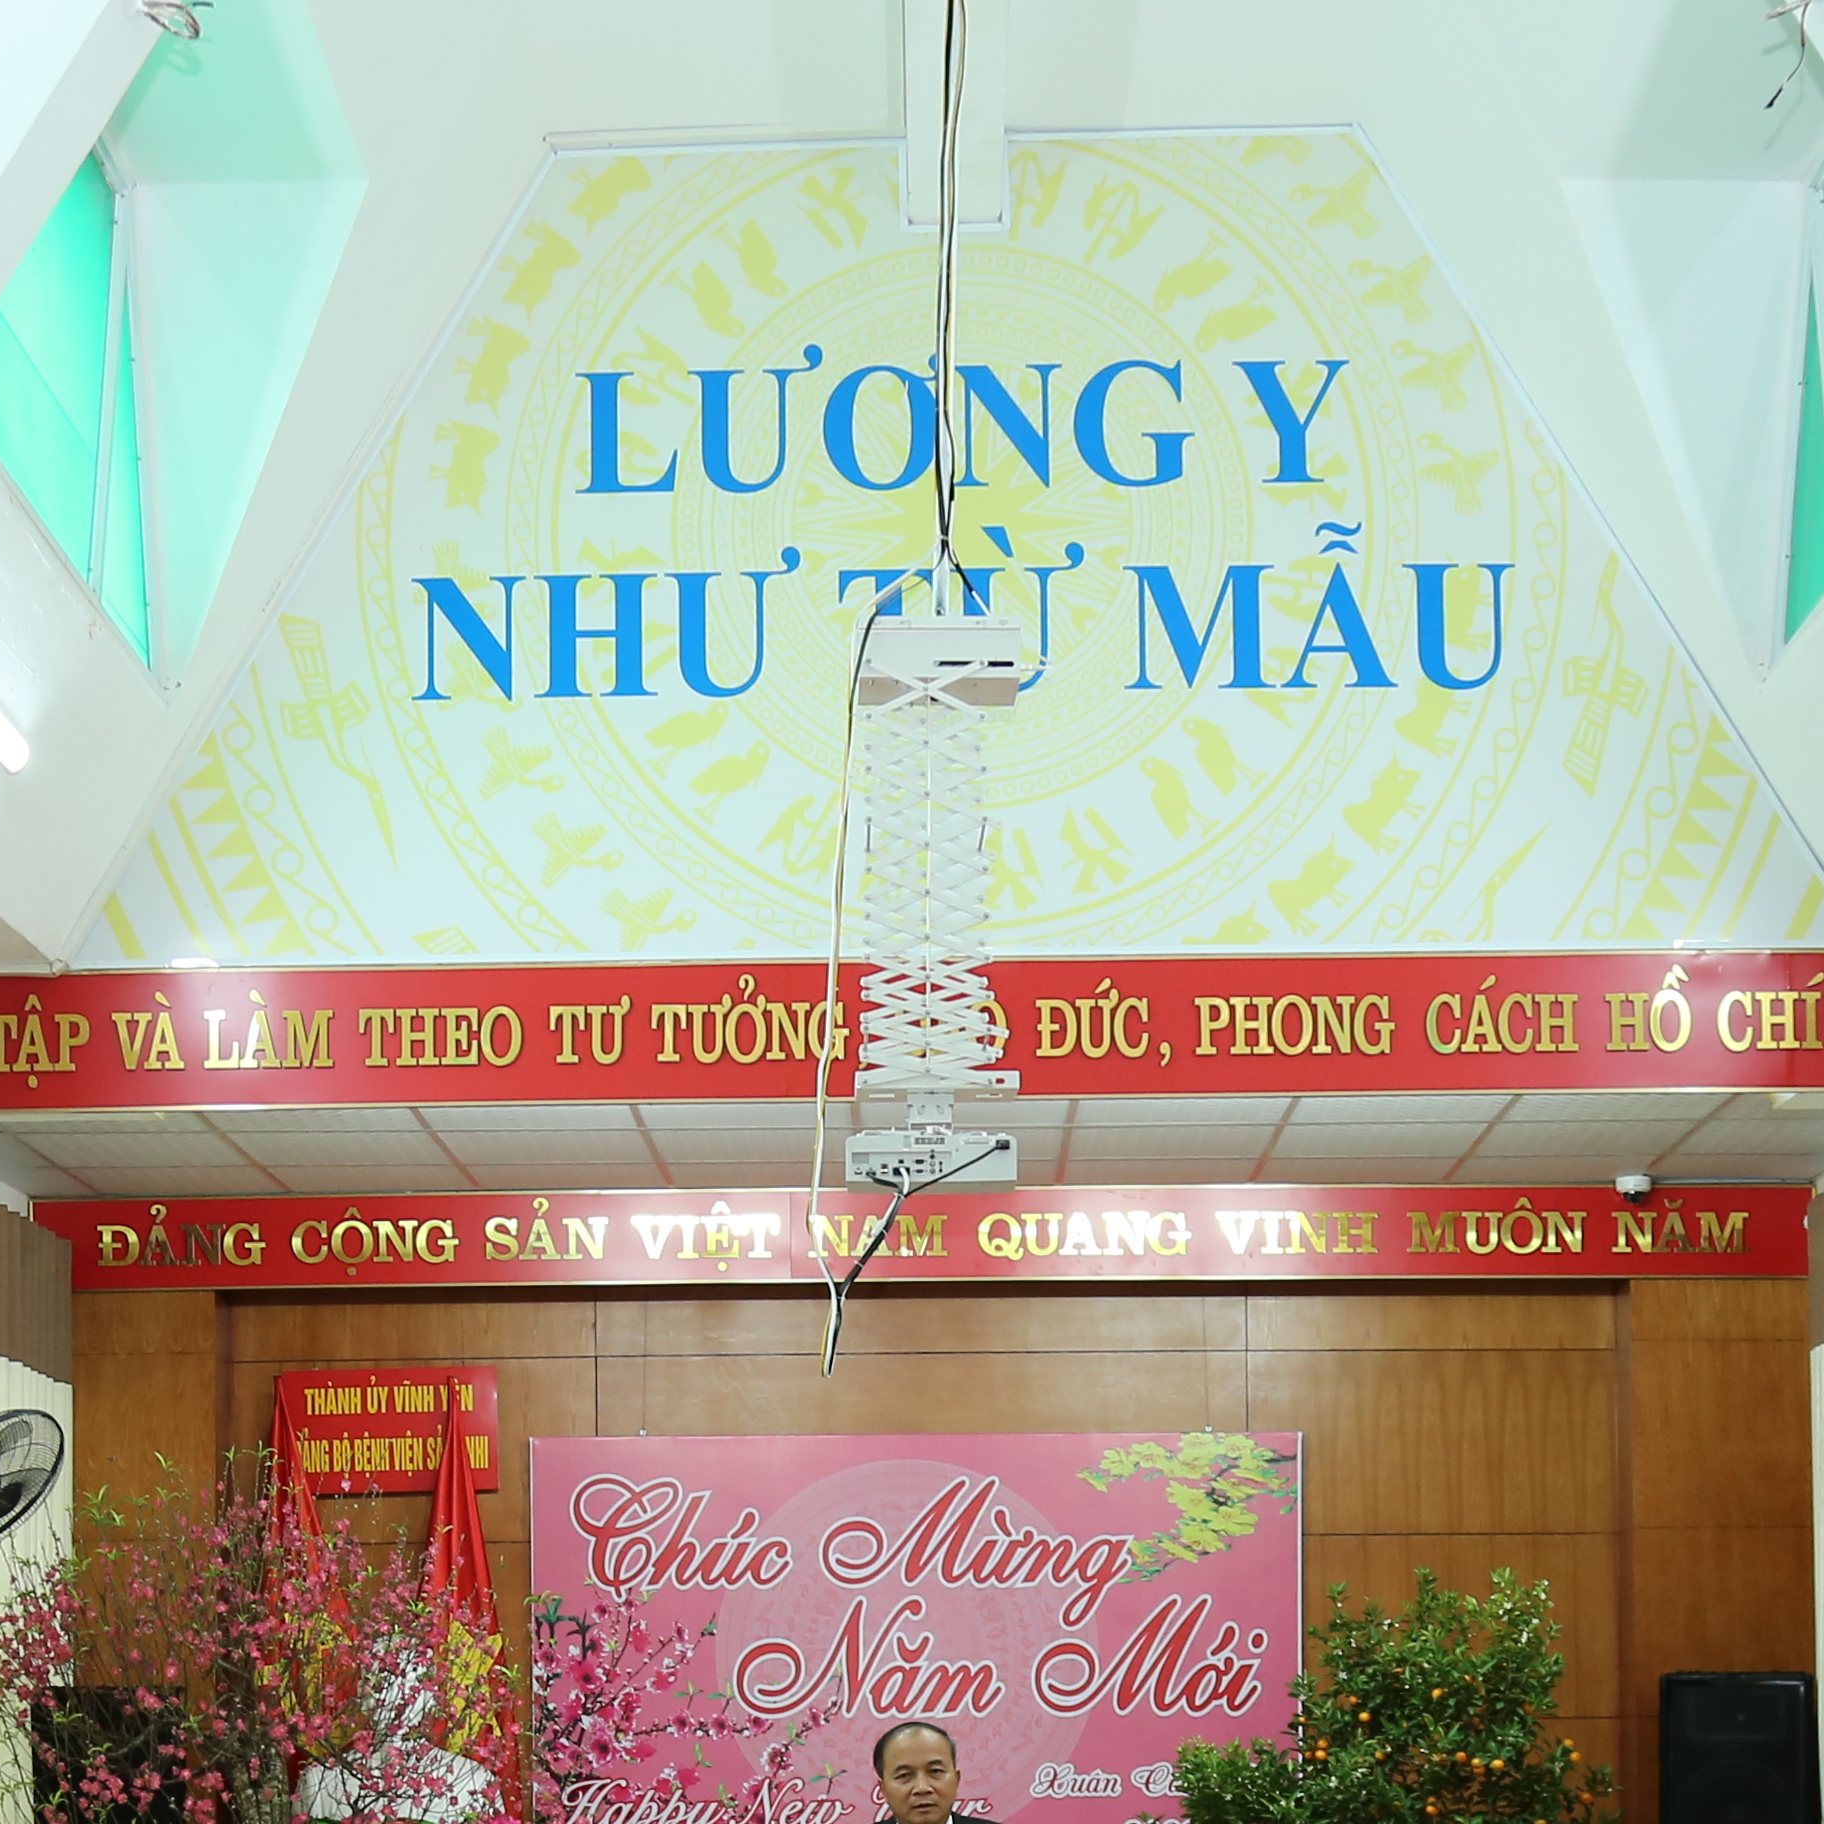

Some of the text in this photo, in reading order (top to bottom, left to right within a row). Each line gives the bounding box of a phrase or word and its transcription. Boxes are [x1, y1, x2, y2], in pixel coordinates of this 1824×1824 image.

[576, 344, 1349, 495] LƯƠNG Y
[411, 546, 802, 702] NHƯ
[1124, 521, 1515, 692] MẪU
[111, 993, 185, 1071] VÀ
[203, 990, 335, 1070] LÀM
[358, 1005, 523, 1069] THEO
[548, 995, 632, 1066] TƯ
[650, 975, 867, 1069] TƯỞNG
[1035, 976, 1173, 1068] ĐỨC,
[1194, 993, 1397, 1057] PHONG
[1425, 975, 1580, 1056] CÁCH
[1606, 964, 1693, 1055] HỒ
[1716, 974, 1824, 1054] CHÍ
[95, 1196, 1751, 1276] ĐẢNG CỘNG SẢN VIỆT NAM QUANG VINH MUÔN NĂM
[304, 1375, 475, 1416] THÀNH ỦY VĨNH YN
[333, 1431, 352, 1479] BỘ
[354, 1430, 391, 1478] BỆNH
[391, 1429, 424, 1477] VIỆN
[569, 1473, 1134, 1630] Chúc Mừng
[732, 1593, 1269, 1720] Năm Mới
[1029, 1761, 1123, 1799] Xuân
